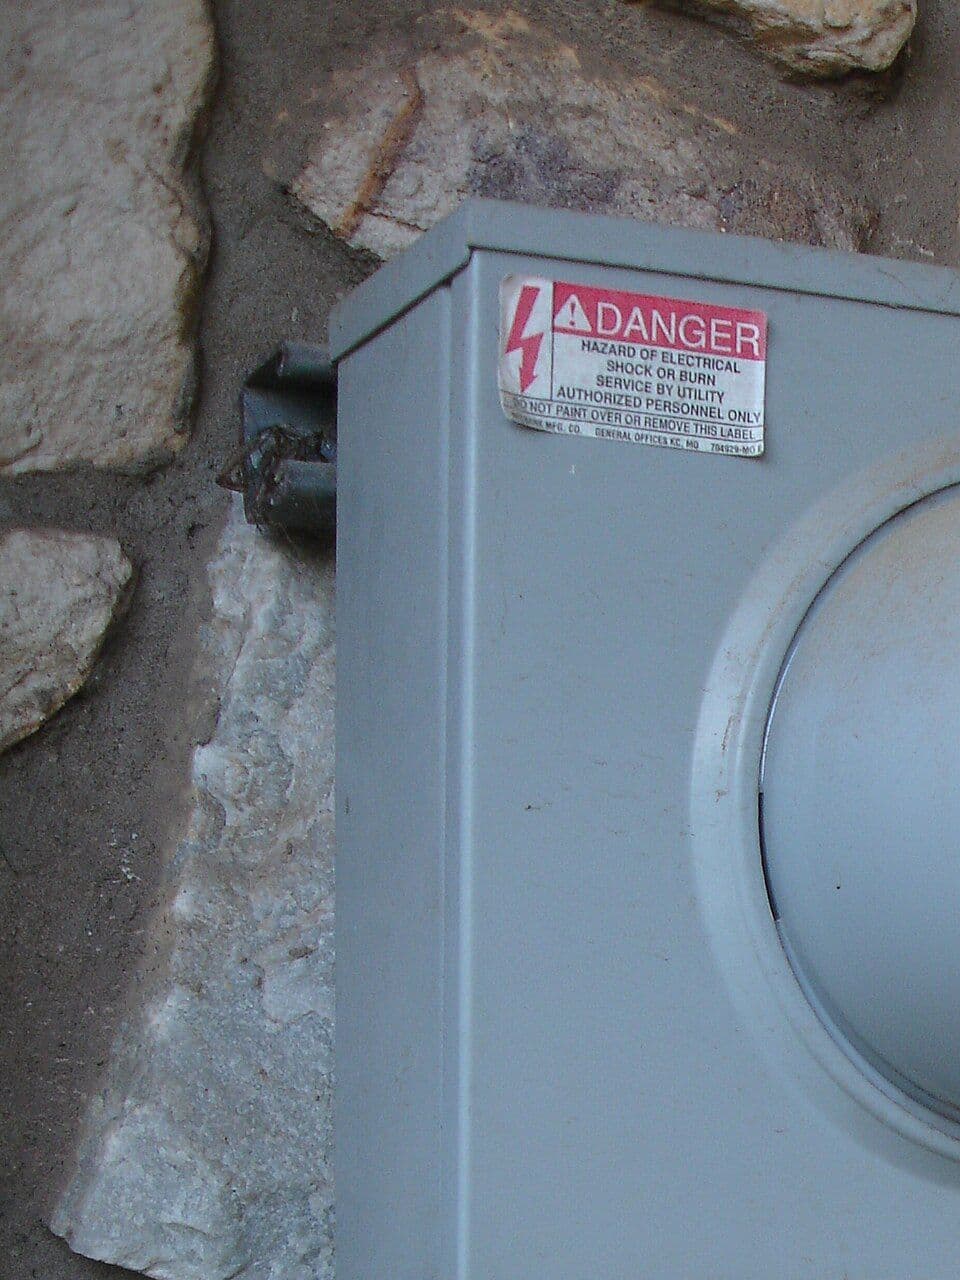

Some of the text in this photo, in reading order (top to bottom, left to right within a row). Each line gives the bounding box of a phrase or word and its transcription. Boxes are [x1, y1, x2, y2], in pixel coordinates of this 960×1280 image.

[596, 301, 760, 357] DANGER
[581, 340, 741, 374] HAZARD OF ELECTRICAL
[607, 360, 716, 386] SHOCK OR BURN
[557, 386, 761, 424] AUTHORIZED PERSONNEL ONLY
[596, 375, 725, 404] SERVICE BY UTILITY
[529, 401, 552, 414] NOT
[556, 405, 587, 420] PAINT
[591, 410, 621, 423] OVER
[624, 414, 641, 426] OR
[644, 416, 691, 433] REMOVE
[693, 423, 718, 437] THIS
[721, 428, 756, 441] LABEL
[595, 428, 632, 441] GENERAL
[634, 432, 668, 445] OFFICES
